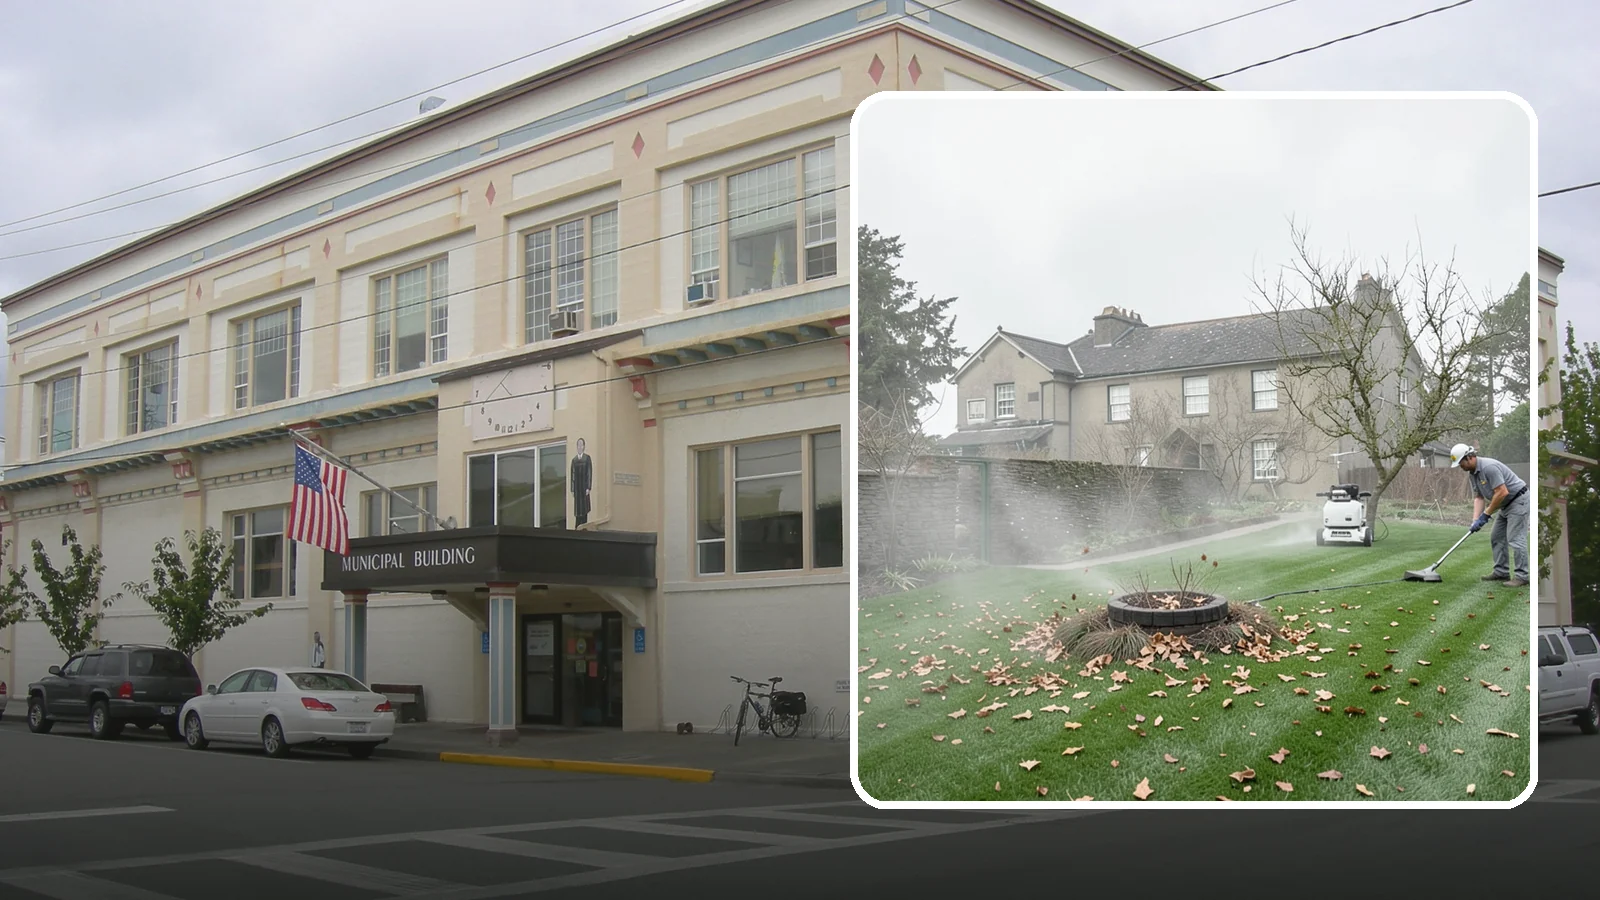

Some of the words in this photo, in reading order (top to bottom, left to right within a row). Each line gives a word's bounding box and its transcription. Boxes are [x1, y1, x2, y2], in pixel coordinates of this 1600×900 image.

[481, 407, 485, 415] 8
[488, 418, 492, 426] 9
[529, 414, 533, 422] 3
[521, 420, 525, 428] 2
[495, 424, 500, 432] 10
[502, 426, 506, 434] 11
[508, 426, 513, 434] 12
[342, 552, 405, 571] MUNICIPAL
[414, 546, 475, 567] BUILDING
